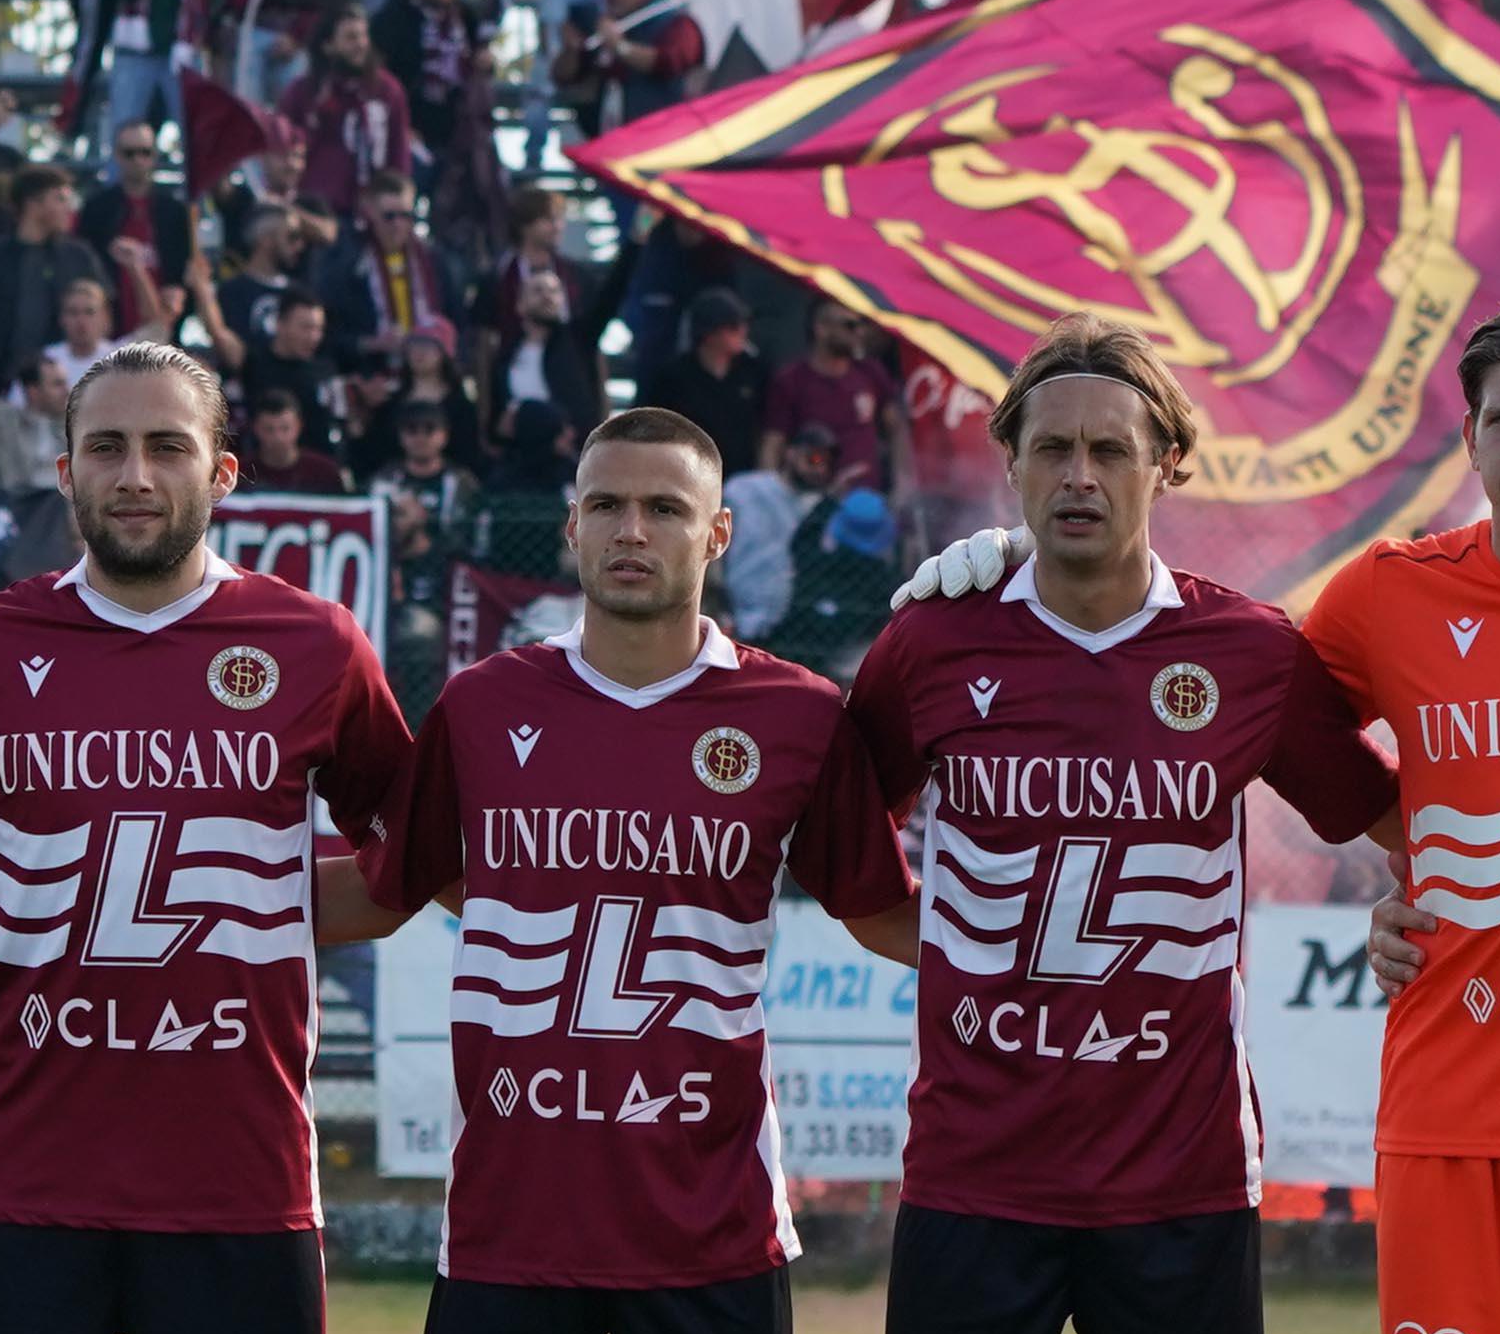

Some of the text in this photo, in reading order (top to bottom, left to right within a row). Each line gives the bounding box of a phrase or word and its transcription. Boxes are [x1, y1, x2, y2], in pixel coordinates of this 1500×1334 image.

[945, 754, 1219, 822] UNICUSANO
[482, 807, 751, 882] UNICUSANO
[57, 997, 248, 1051] CLAS
[988, 1001, 1171, 1063] CLAS
[527, 1067, 712, 1125] CLAS
